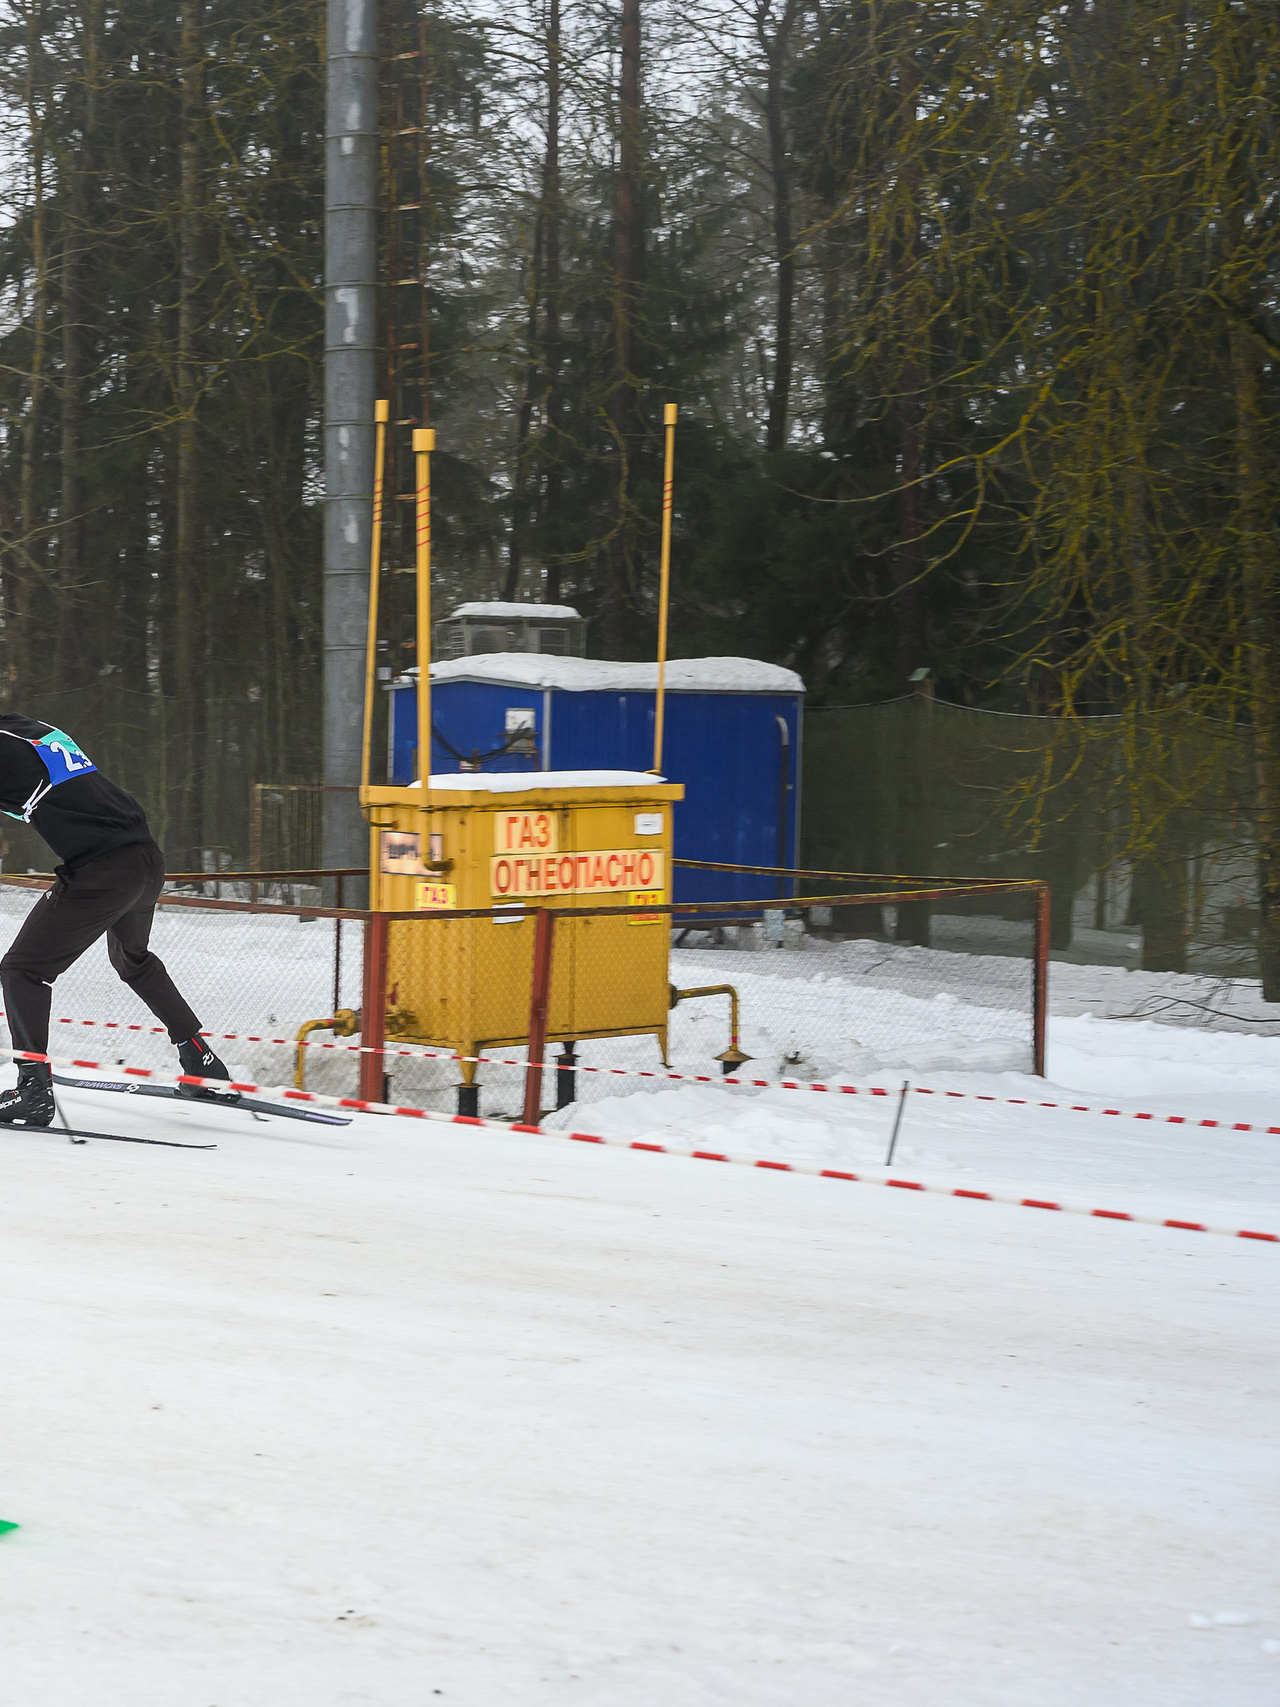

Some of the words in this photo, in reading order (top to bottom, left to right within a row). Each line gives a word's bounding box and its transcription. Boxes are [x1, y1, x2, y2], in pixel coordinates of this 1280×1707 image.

[50, 741, 93, 772] 23
[505, 814, 552, 849] ГАЗ
[495, 853, 655, 893] ОГНЕОПАСНО
[422, 886, 449, 904] ГАЗ
